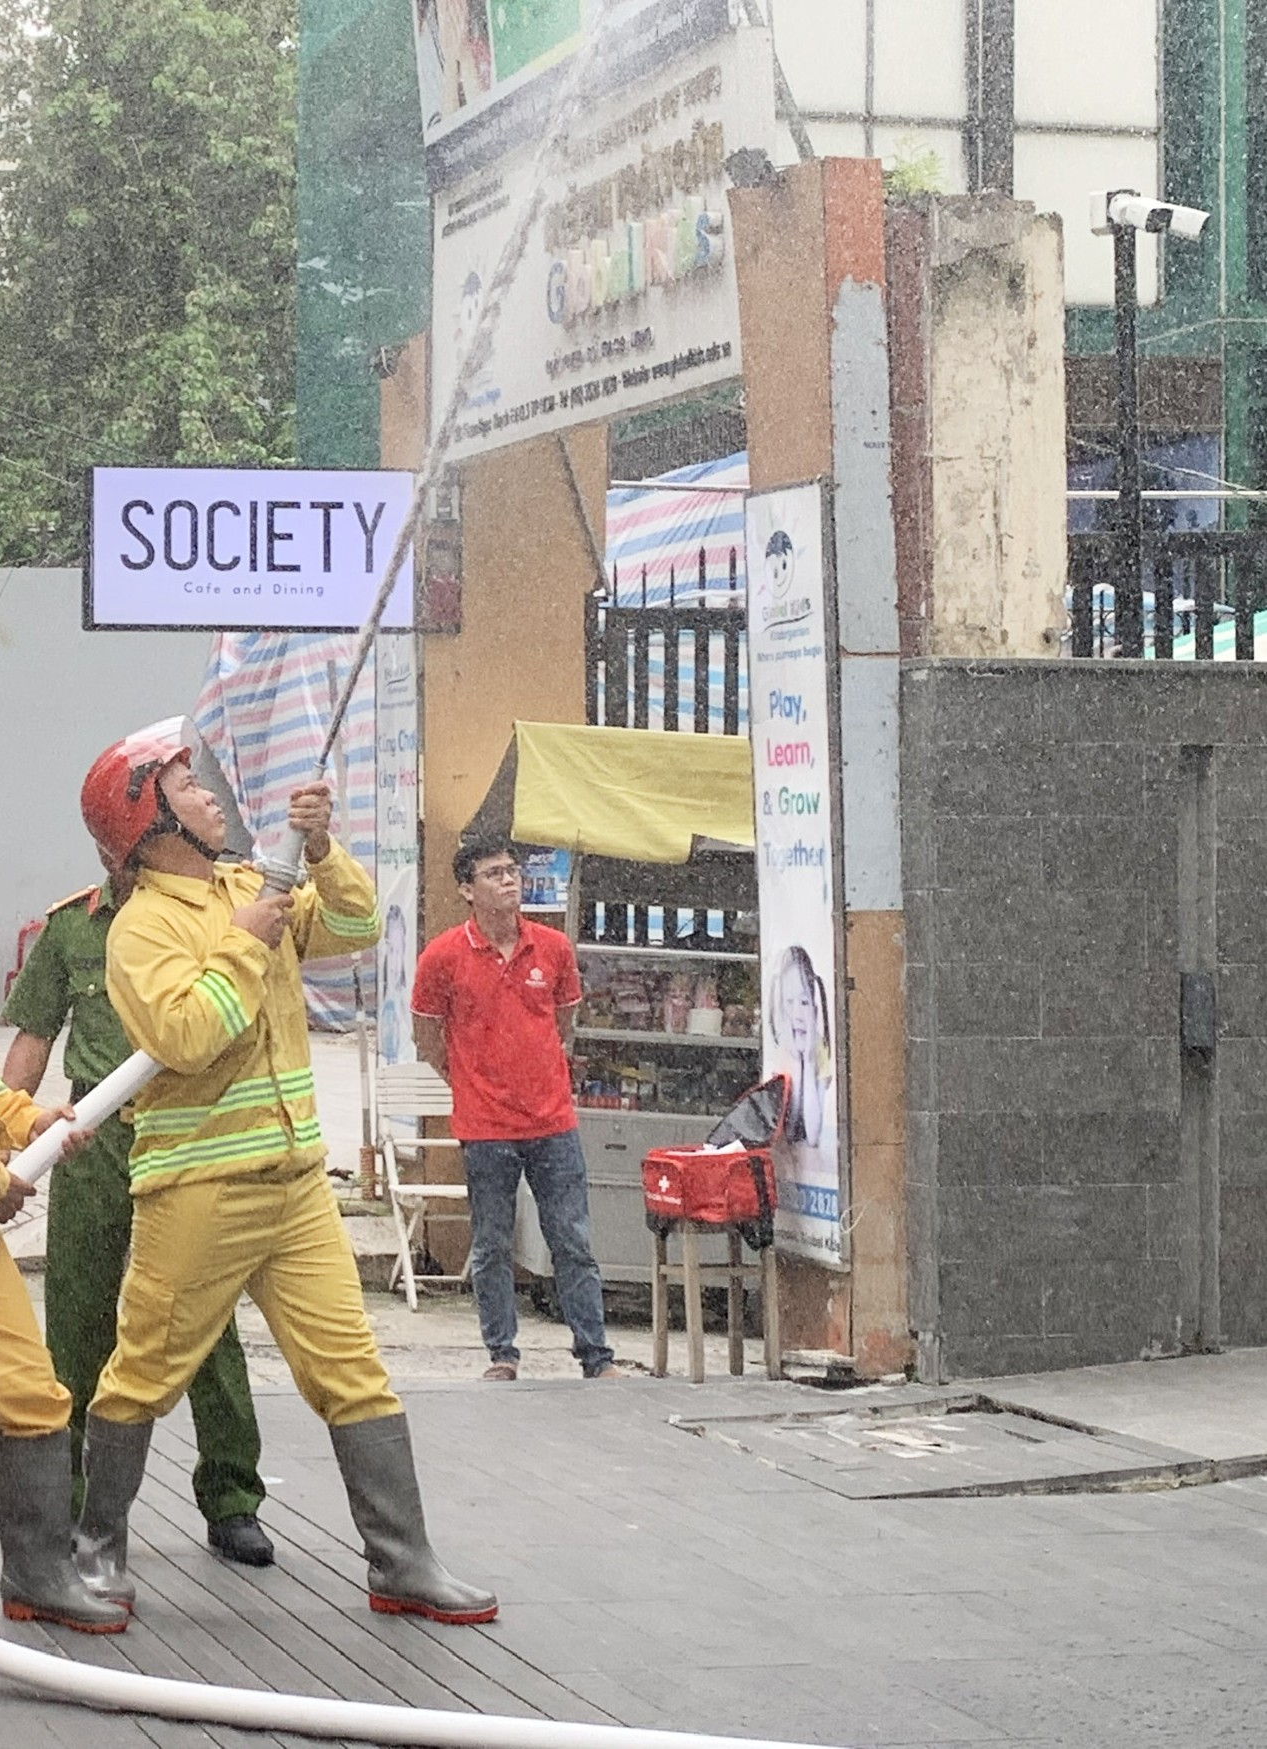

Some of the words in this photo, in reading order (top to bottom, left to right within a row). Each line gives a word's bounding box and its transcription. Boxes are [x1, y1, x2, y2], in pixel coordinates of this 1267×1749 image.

[120, 499, 386, 573] SOCIETY
[184, 581, 221, 594] Cafe
[233, 583, 262, 595] and
[273, 583, 324, 597] Dining
[769, 688, 807, 725] Play,
[766, 738, 816, 769] Learn,
[763, 790, 773, 816] &
[778, 786, 821, 815] Grow
